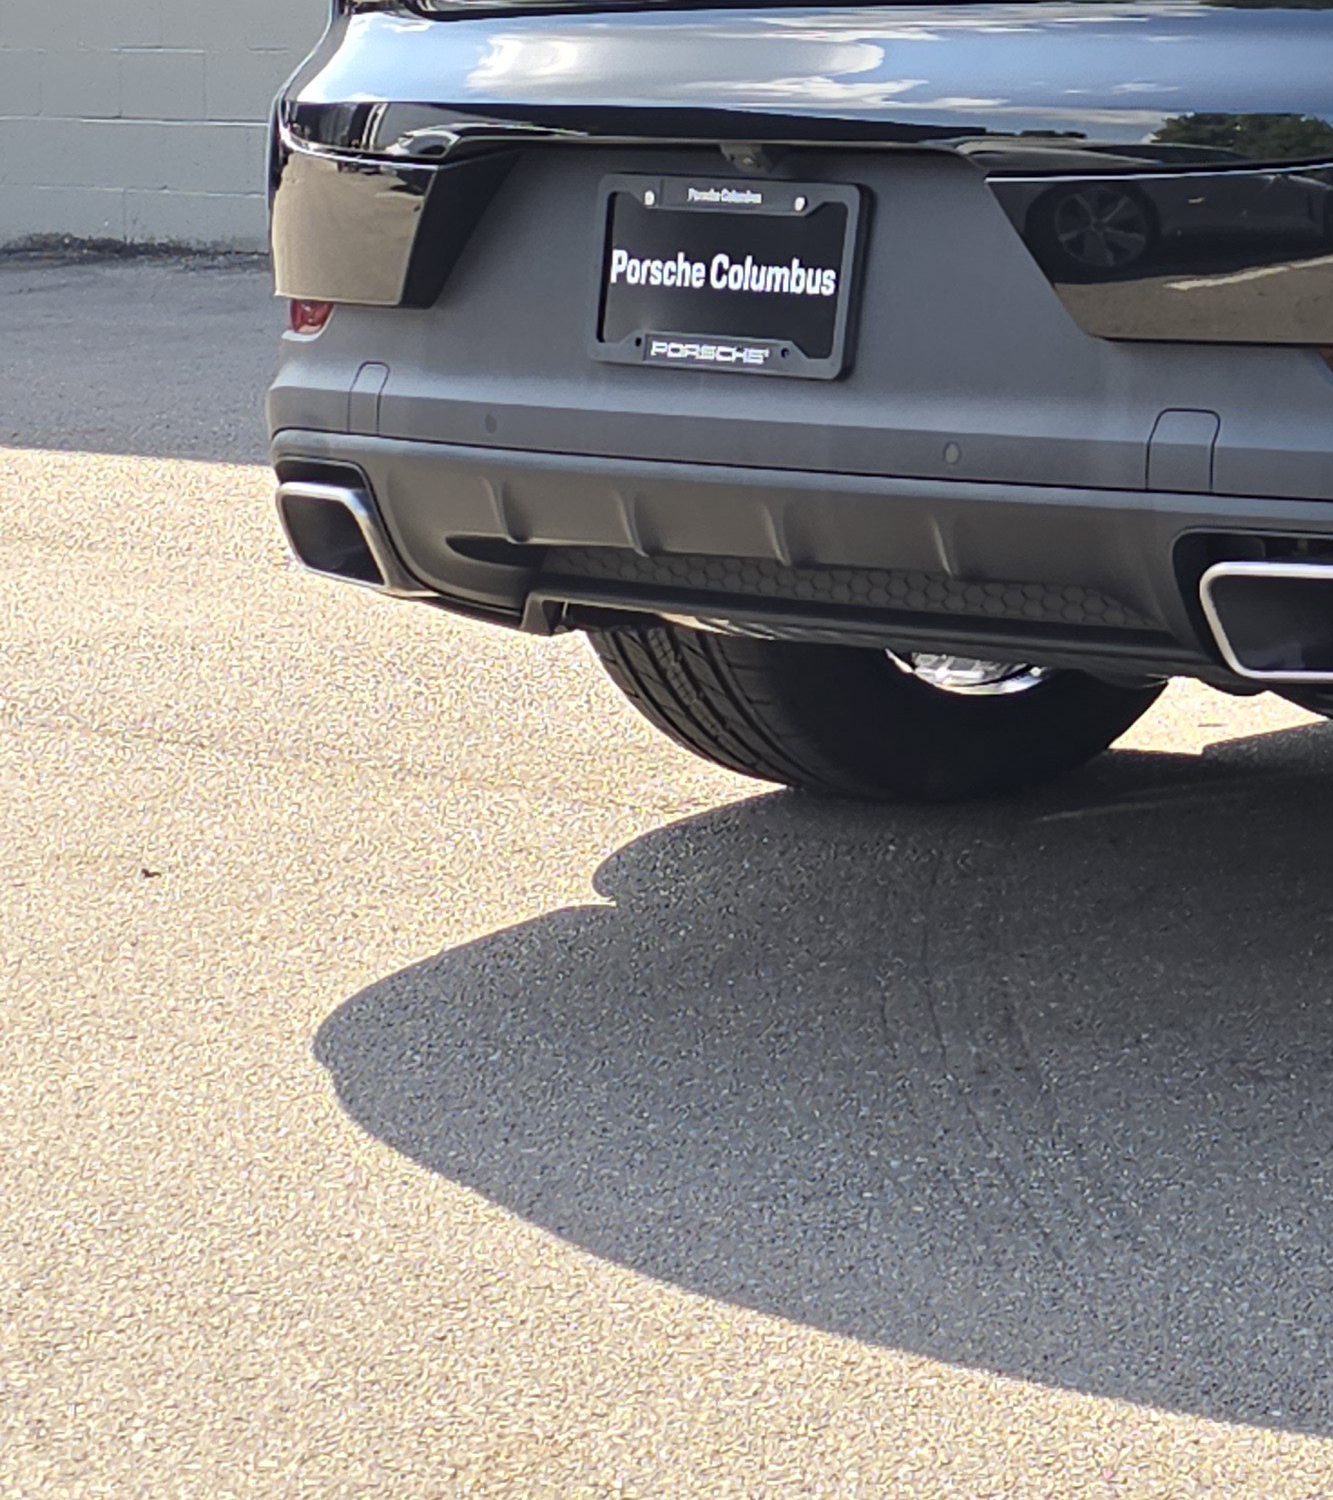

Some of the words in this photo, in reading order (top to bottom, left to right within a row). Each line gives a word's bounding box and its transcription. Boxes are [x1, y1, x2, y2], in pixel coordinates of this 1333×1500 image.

[610, 248, 706, 289] Porsche
[710, 253, 838, 297] Columbus
[650, 340, 770, 365] PORSCHE
